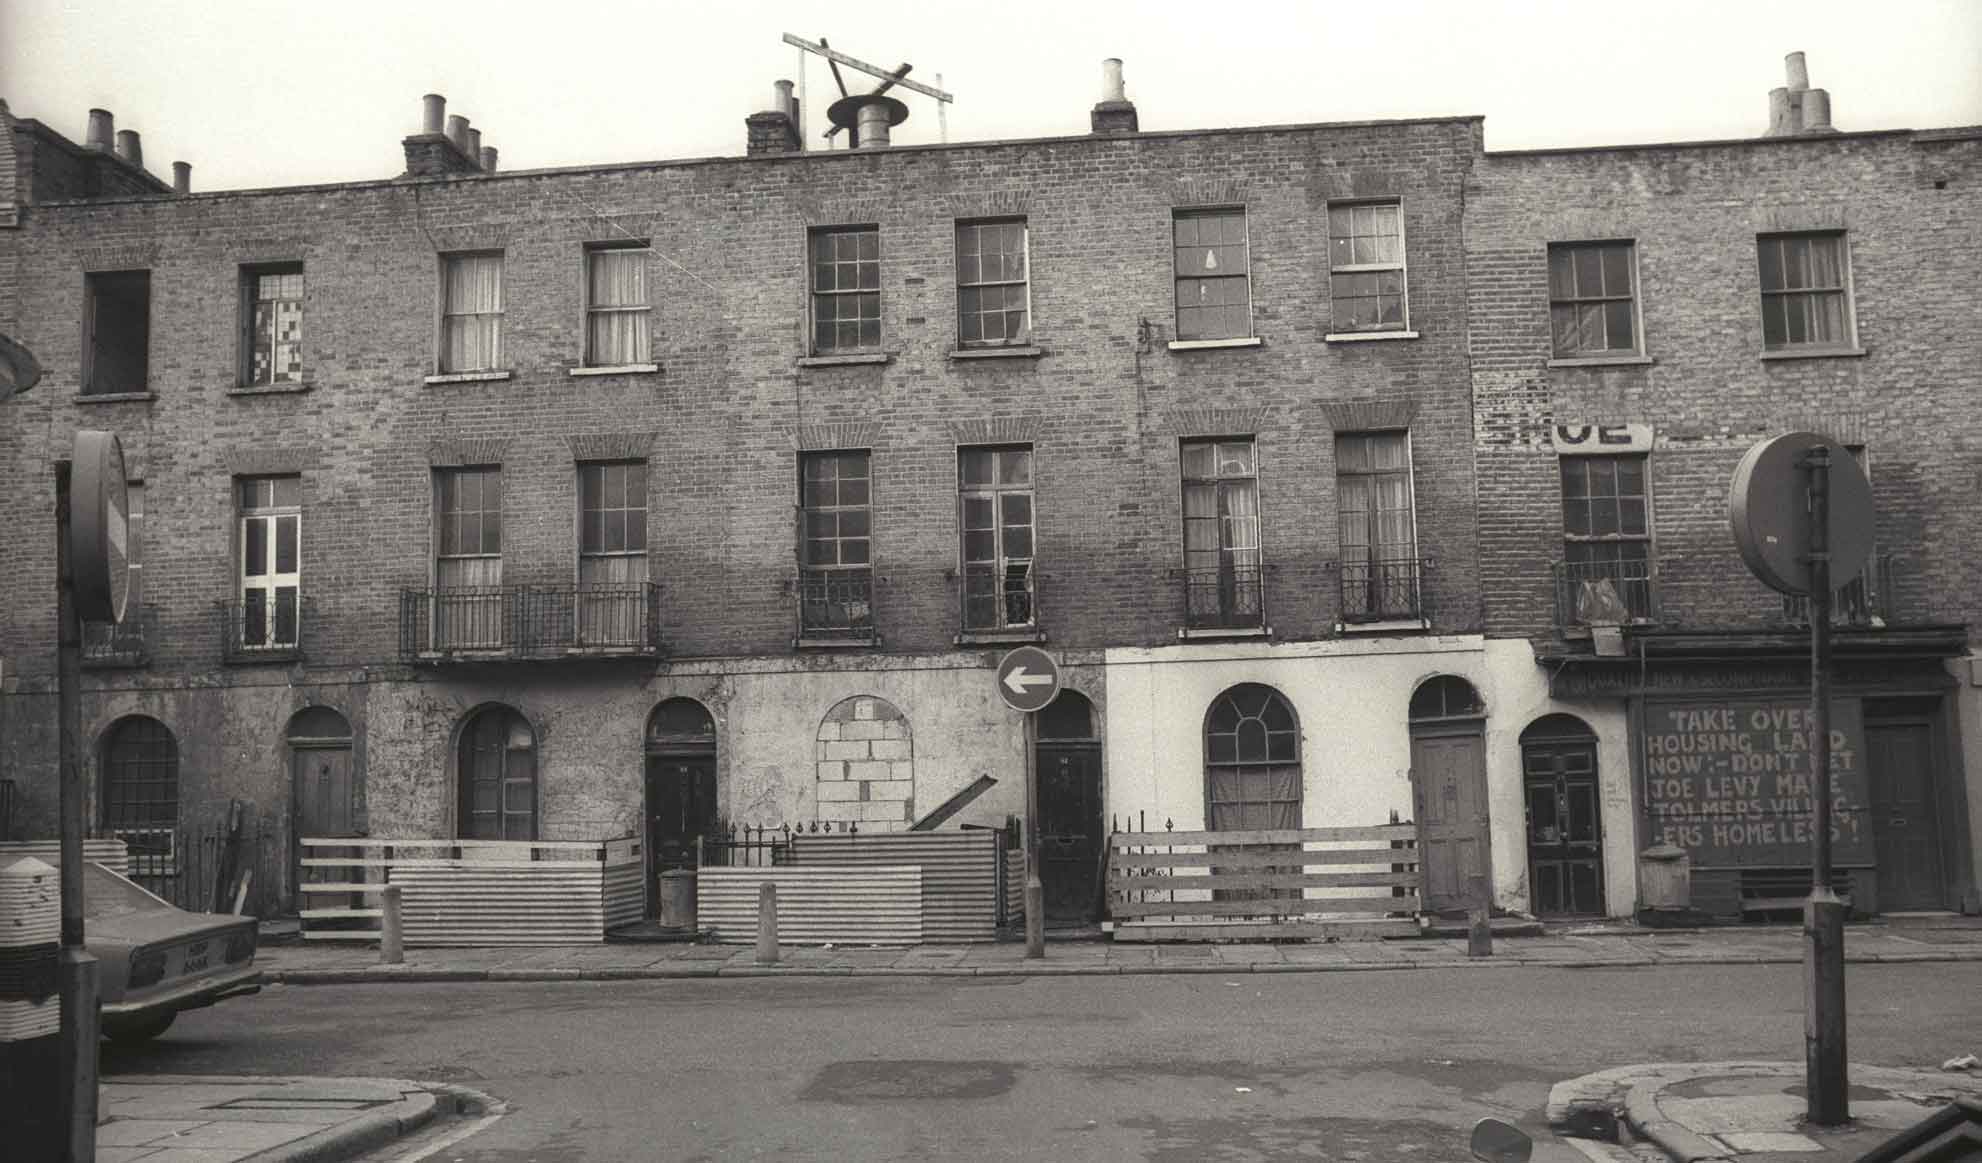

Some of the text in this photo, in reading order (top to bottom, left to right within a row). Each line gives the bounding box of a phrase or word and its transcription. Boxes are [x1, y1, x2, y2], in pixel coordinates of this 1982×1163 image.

[1647, 730, 1846, 755] HOUSING LAD
[1651, 778, 1694, 799] JOE
[1706, 776, 1760, 798] LEVY
[1776, 773, 1841, 795] MAE
[1653, 798, 1762, 823] TOLMERS
